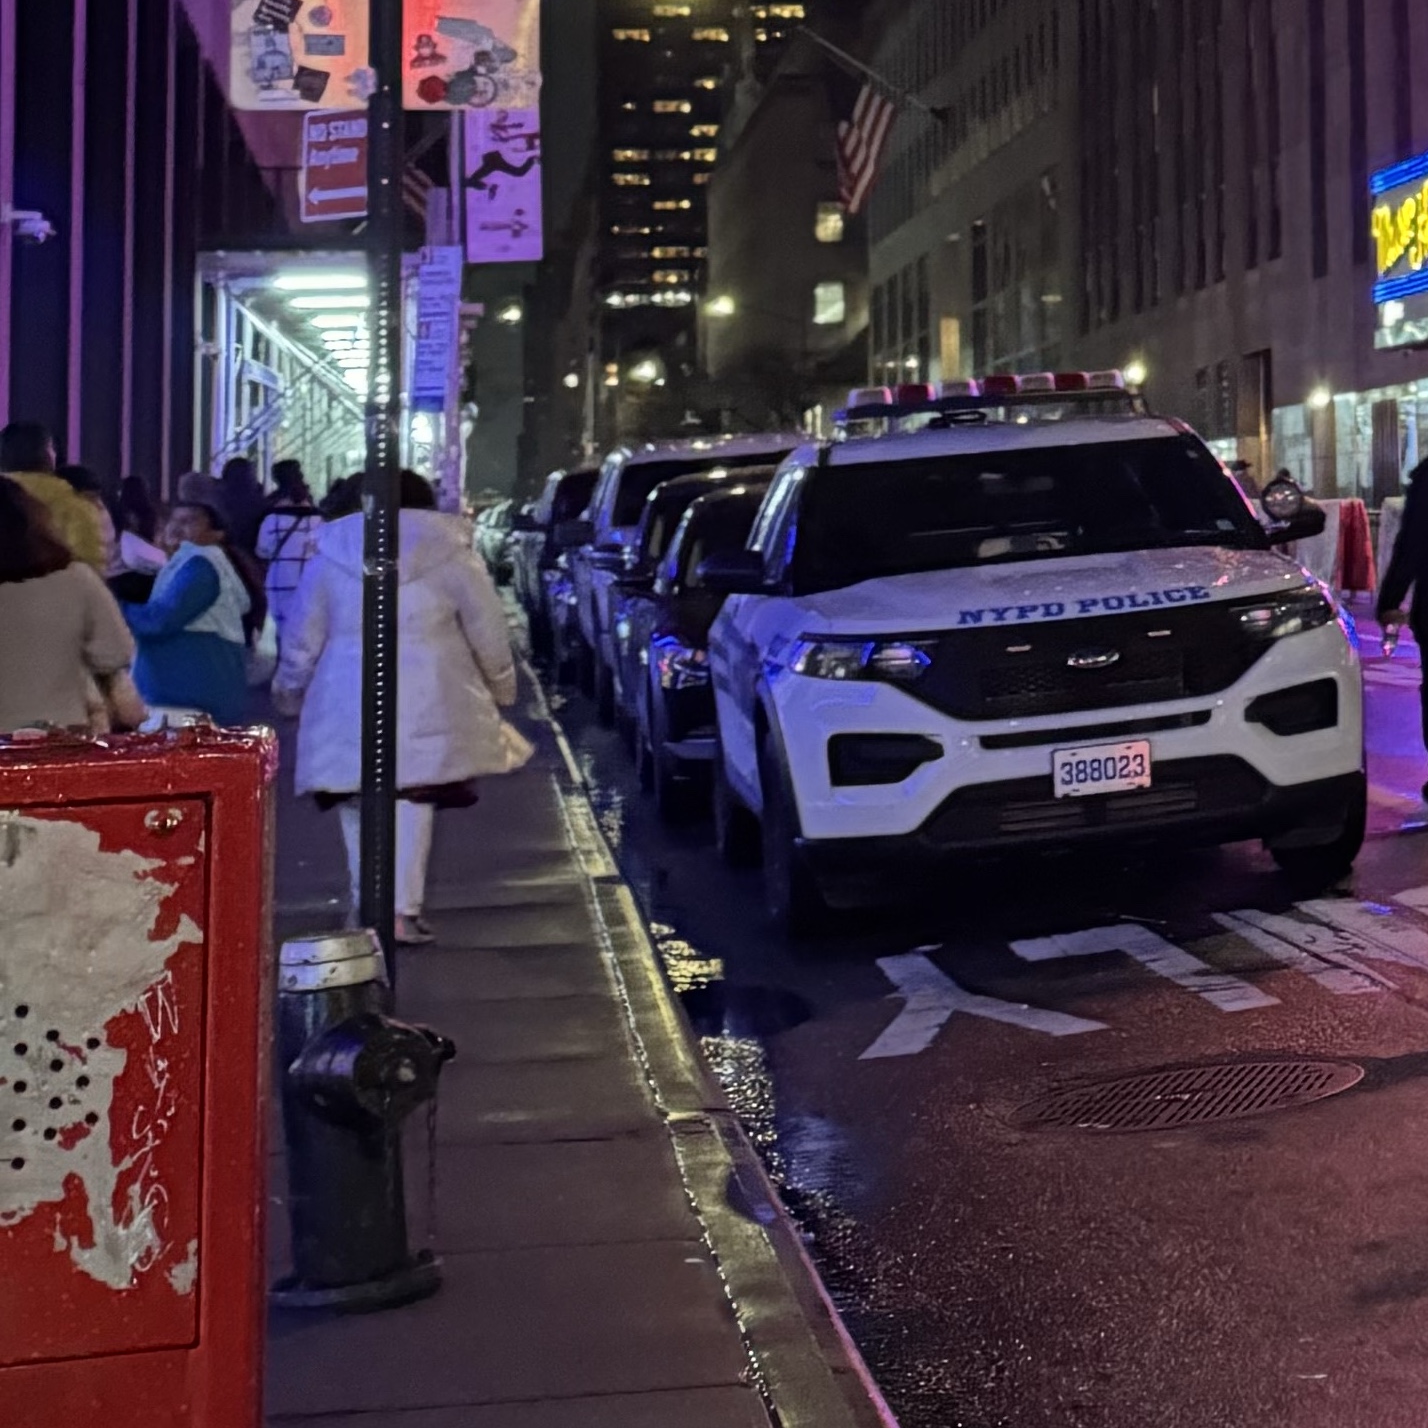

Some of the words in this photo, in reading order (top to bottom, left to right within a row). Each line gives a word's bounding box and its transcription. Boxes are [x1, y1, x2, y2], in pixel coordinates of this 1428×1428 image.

[957, 600, 1066, 626] NYPD
[1077, 585, 1212, 614] POLICE
[1060, 753, 1146, 786] 388023
